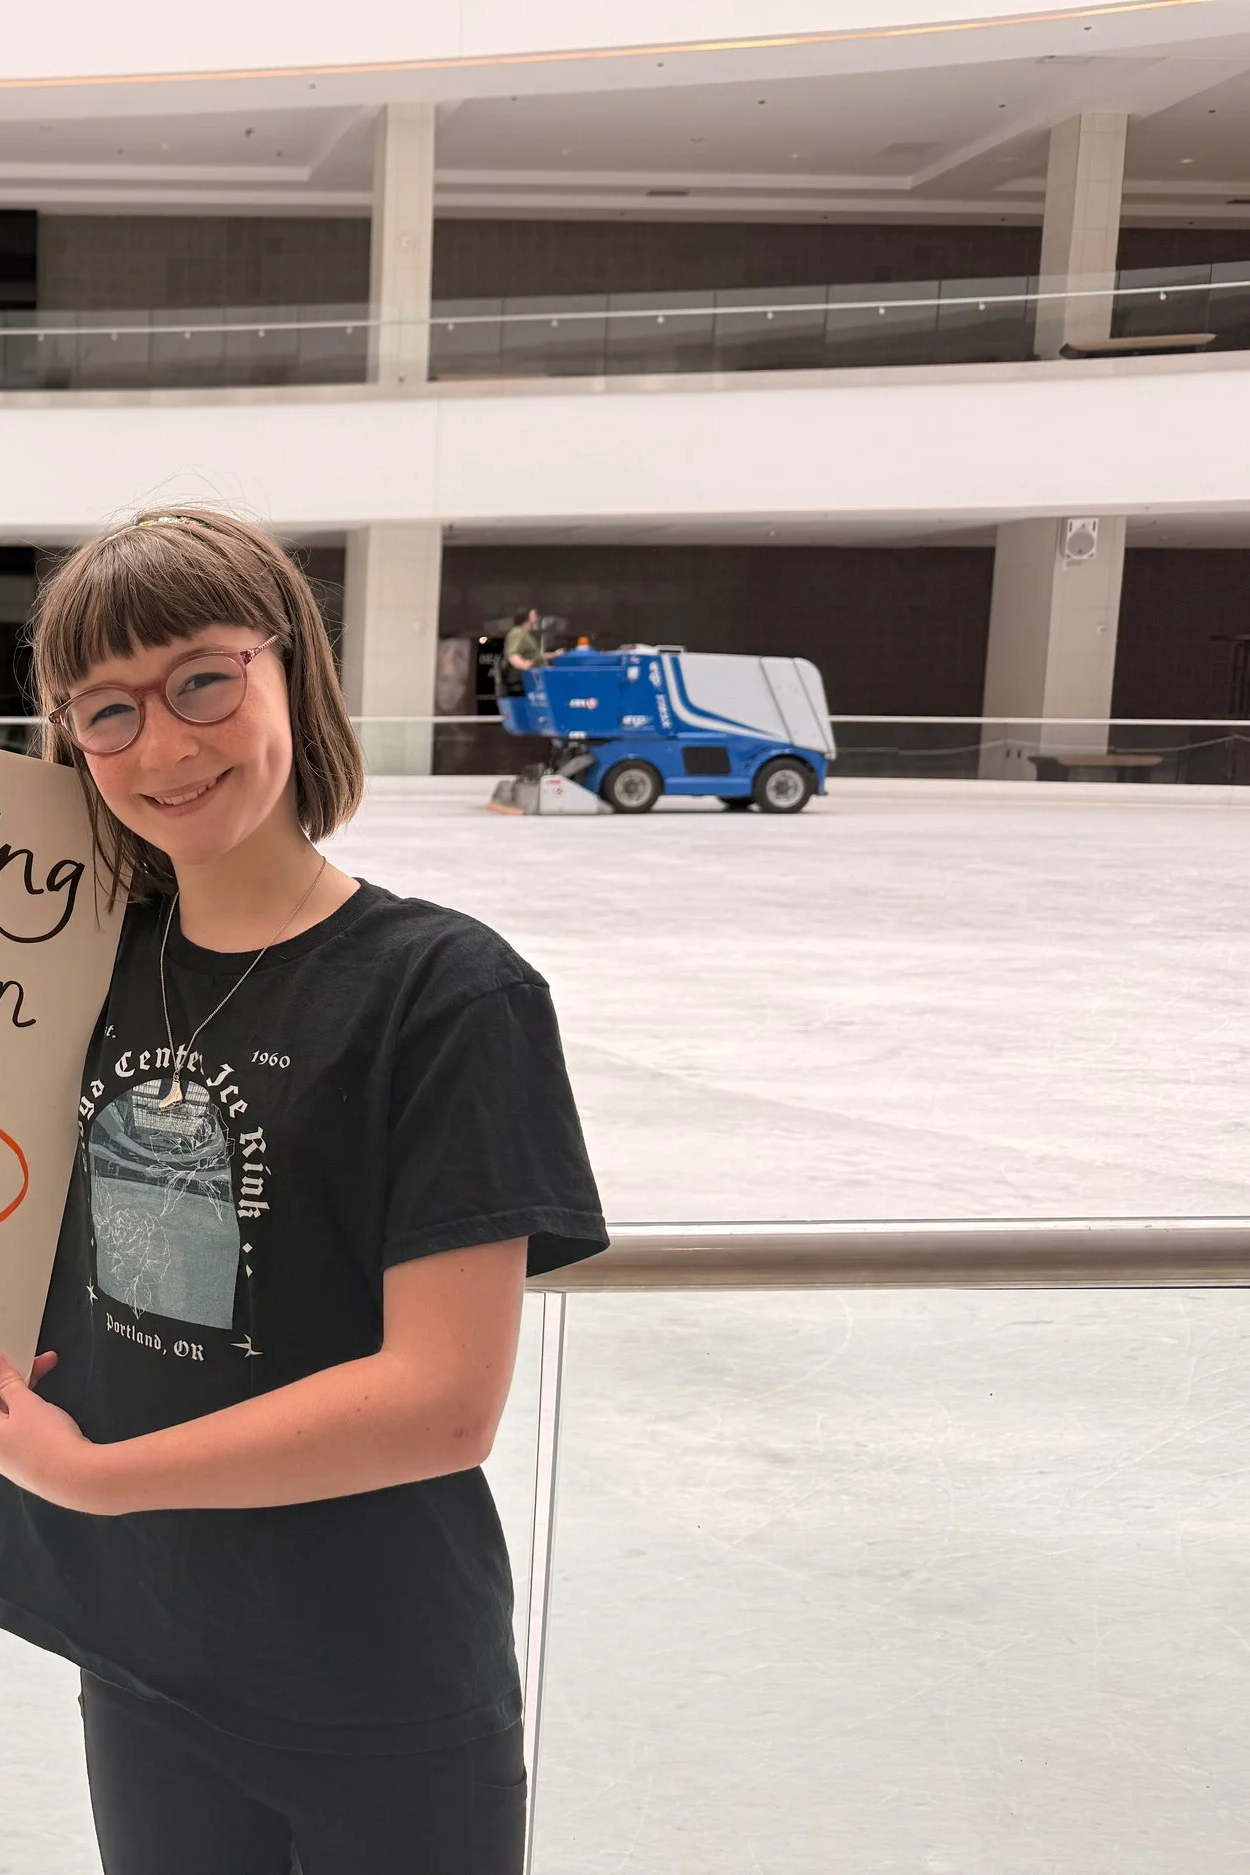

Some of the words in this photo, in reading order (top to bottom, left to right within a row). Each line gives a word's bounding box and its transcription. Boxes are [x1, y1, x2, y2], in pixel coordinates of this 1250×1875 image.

[251, 1050, 291, 1069] 1960
[206, 1063, 249, 1118] Ice
[236, 1126, 272, 1219] Rink
[106, 1312, 167, 1356] Portland,
[173, 1340, 205, 1361] OR
